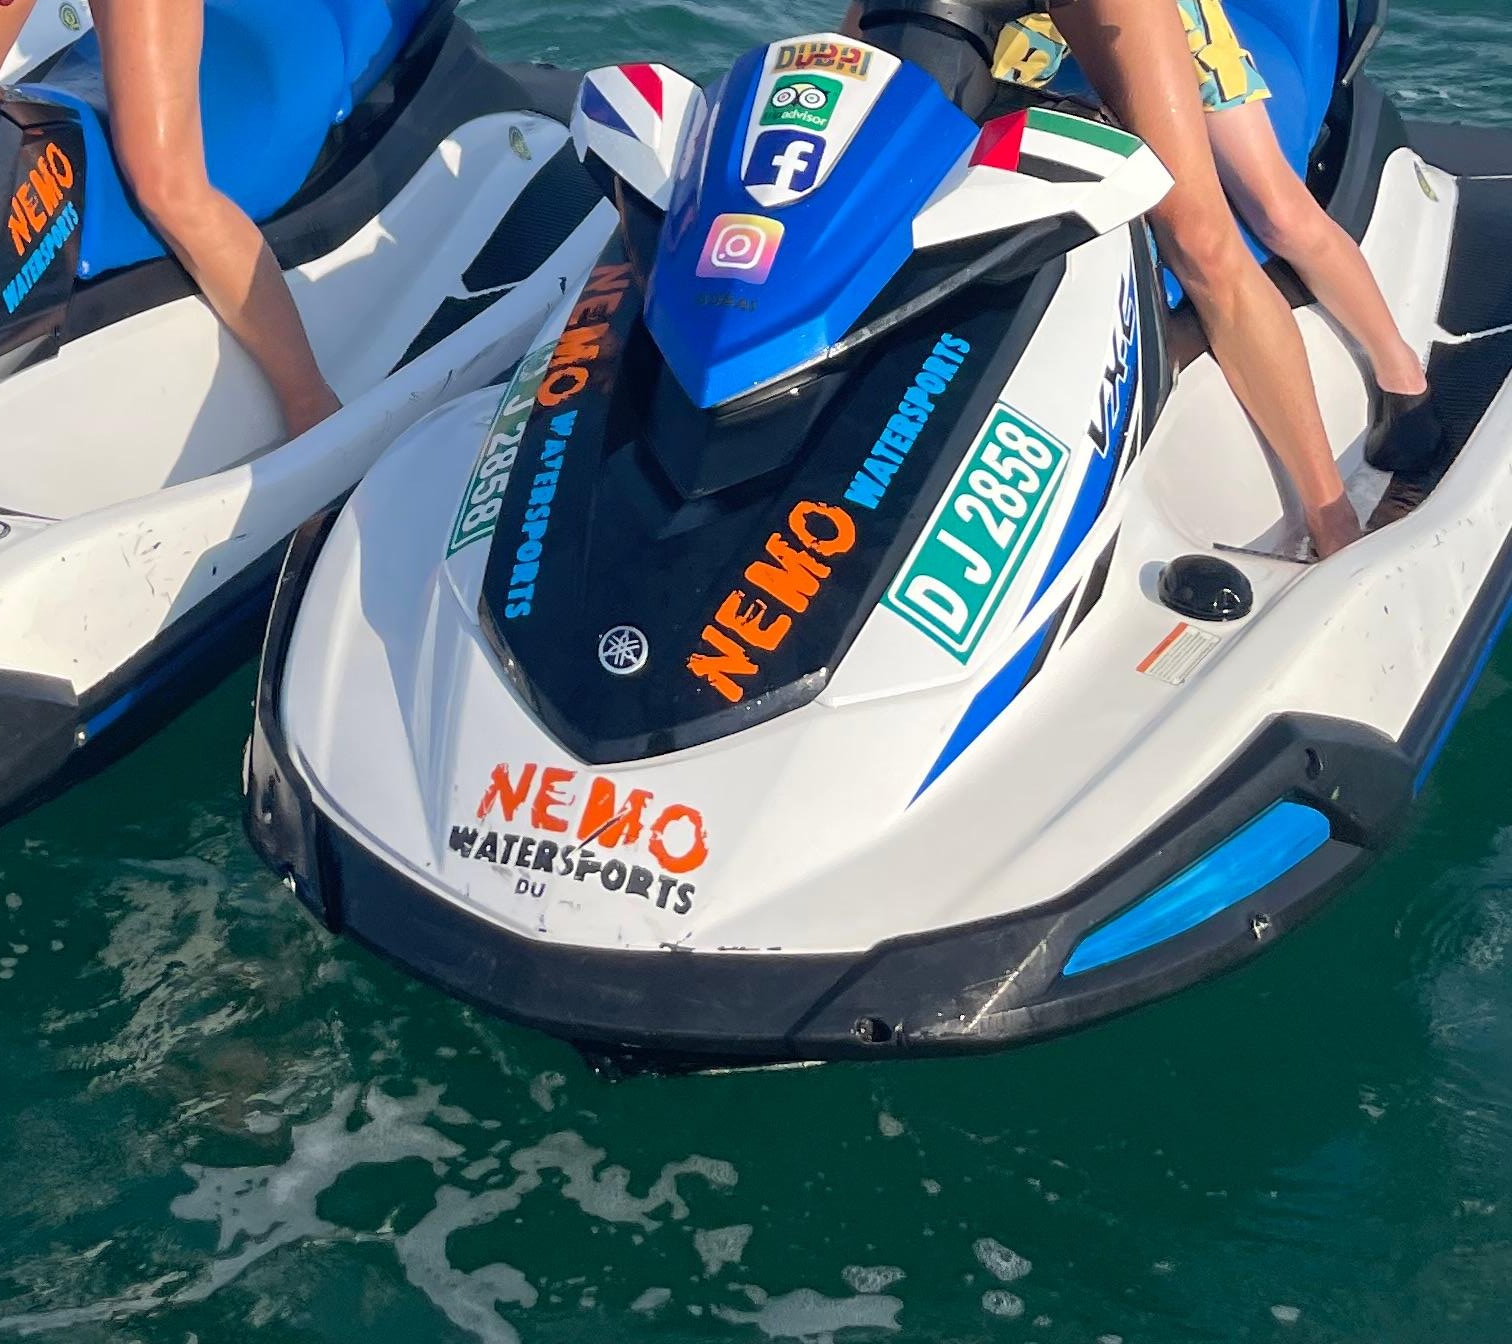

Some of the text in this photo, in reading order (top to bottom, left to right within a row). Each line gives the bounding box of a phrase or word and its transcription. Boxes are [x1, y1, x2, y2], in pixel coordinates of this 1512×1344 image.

[7, 142, 74, 257] NEMO
[771, 140, 816, 192] f
[2, 201, 80, 315] WATERSPORTS
[462, 423, 523, 533] 2858
[504, 261, 634, 619] NEMO WATERSPORTS
[954, 421, 1054, 550] 2858
[686, 332, 971, 703] NEMO WATERSPORTS
[449, 825, 696, 916] WATERSPORTS
[476, 763, 709, 874] NEMO
